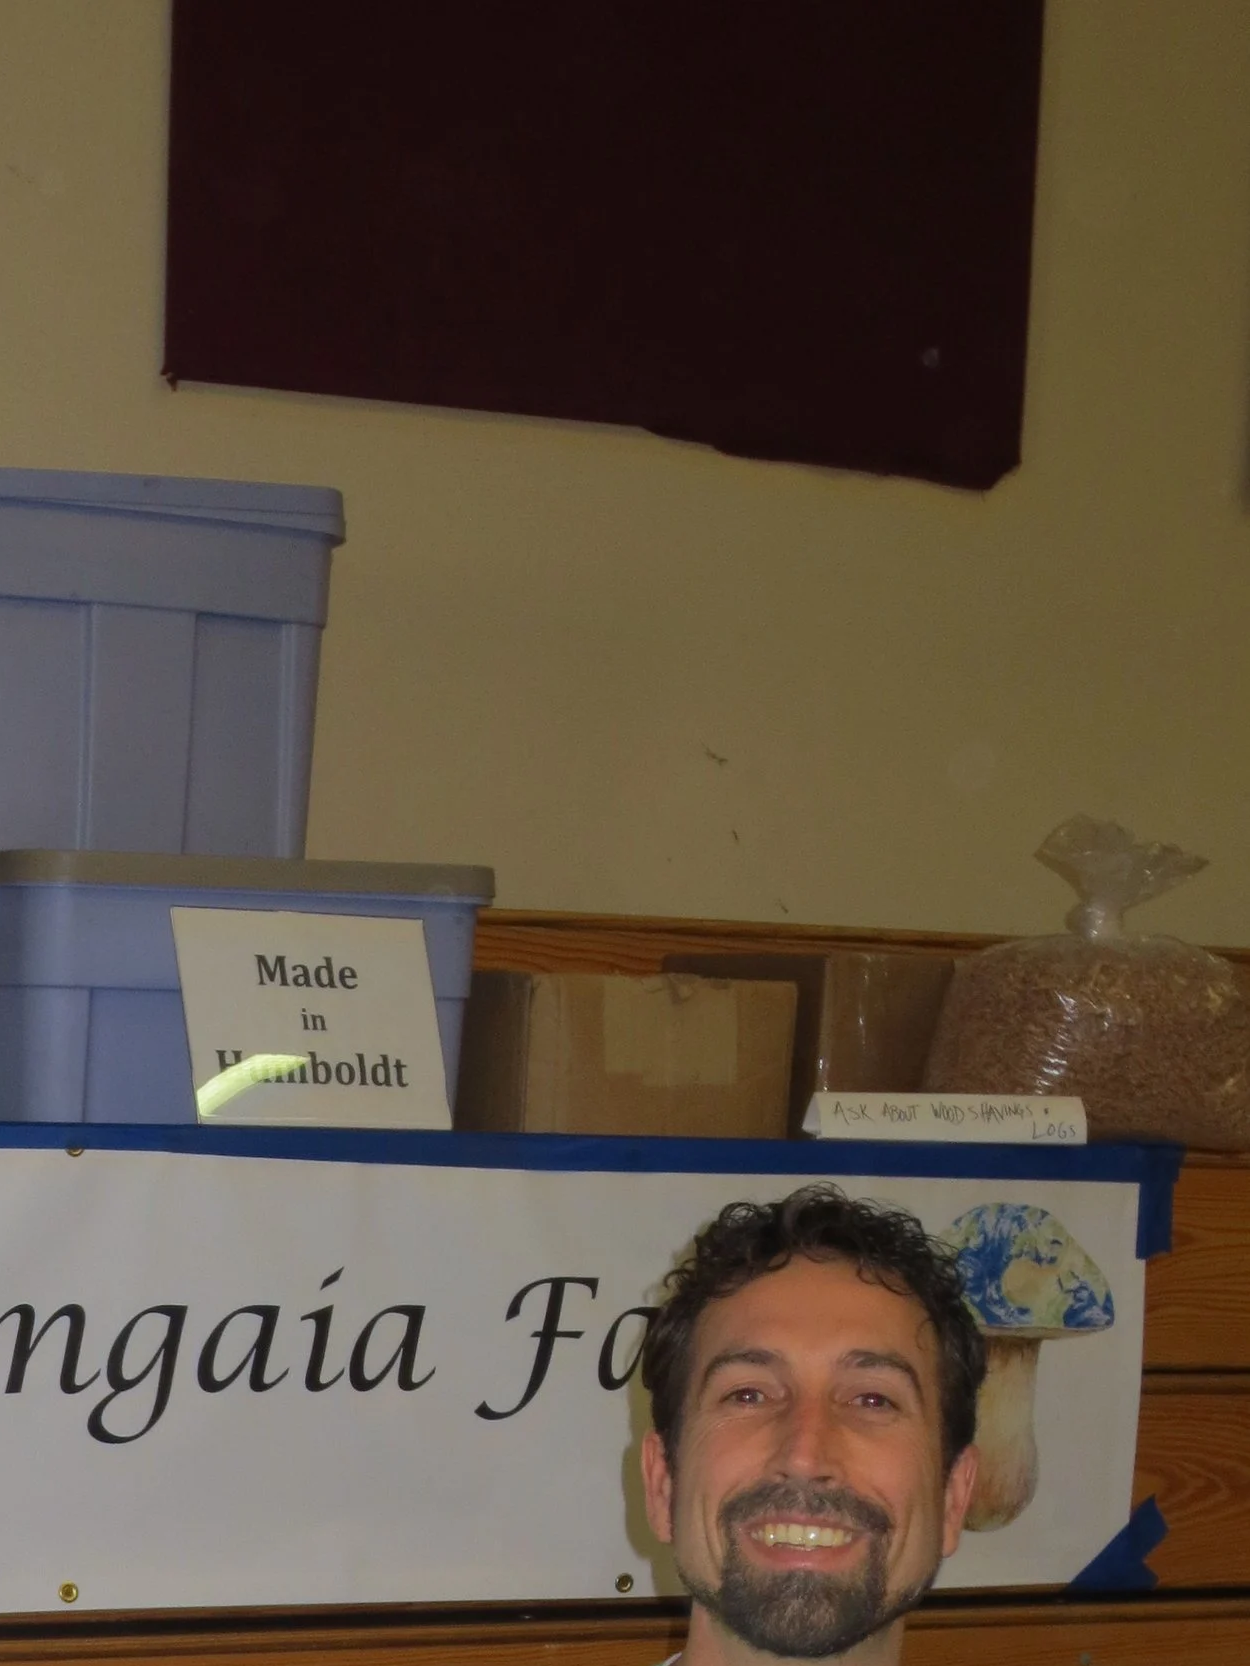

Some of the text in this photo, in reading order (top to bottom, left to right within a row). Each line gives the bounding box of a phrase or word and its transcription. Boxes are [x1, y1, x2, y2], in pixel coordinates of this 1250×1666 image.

[255, 953, 359, 991] Made
[300, 1007, 328, 1033] in
[833, 1101, 874, 1126] ASK
[881, 1102, 919, 1123] ABOUT
[930, 1102, 965, 1125] WOOD
[474, 1276, 661, 1420] Fa
